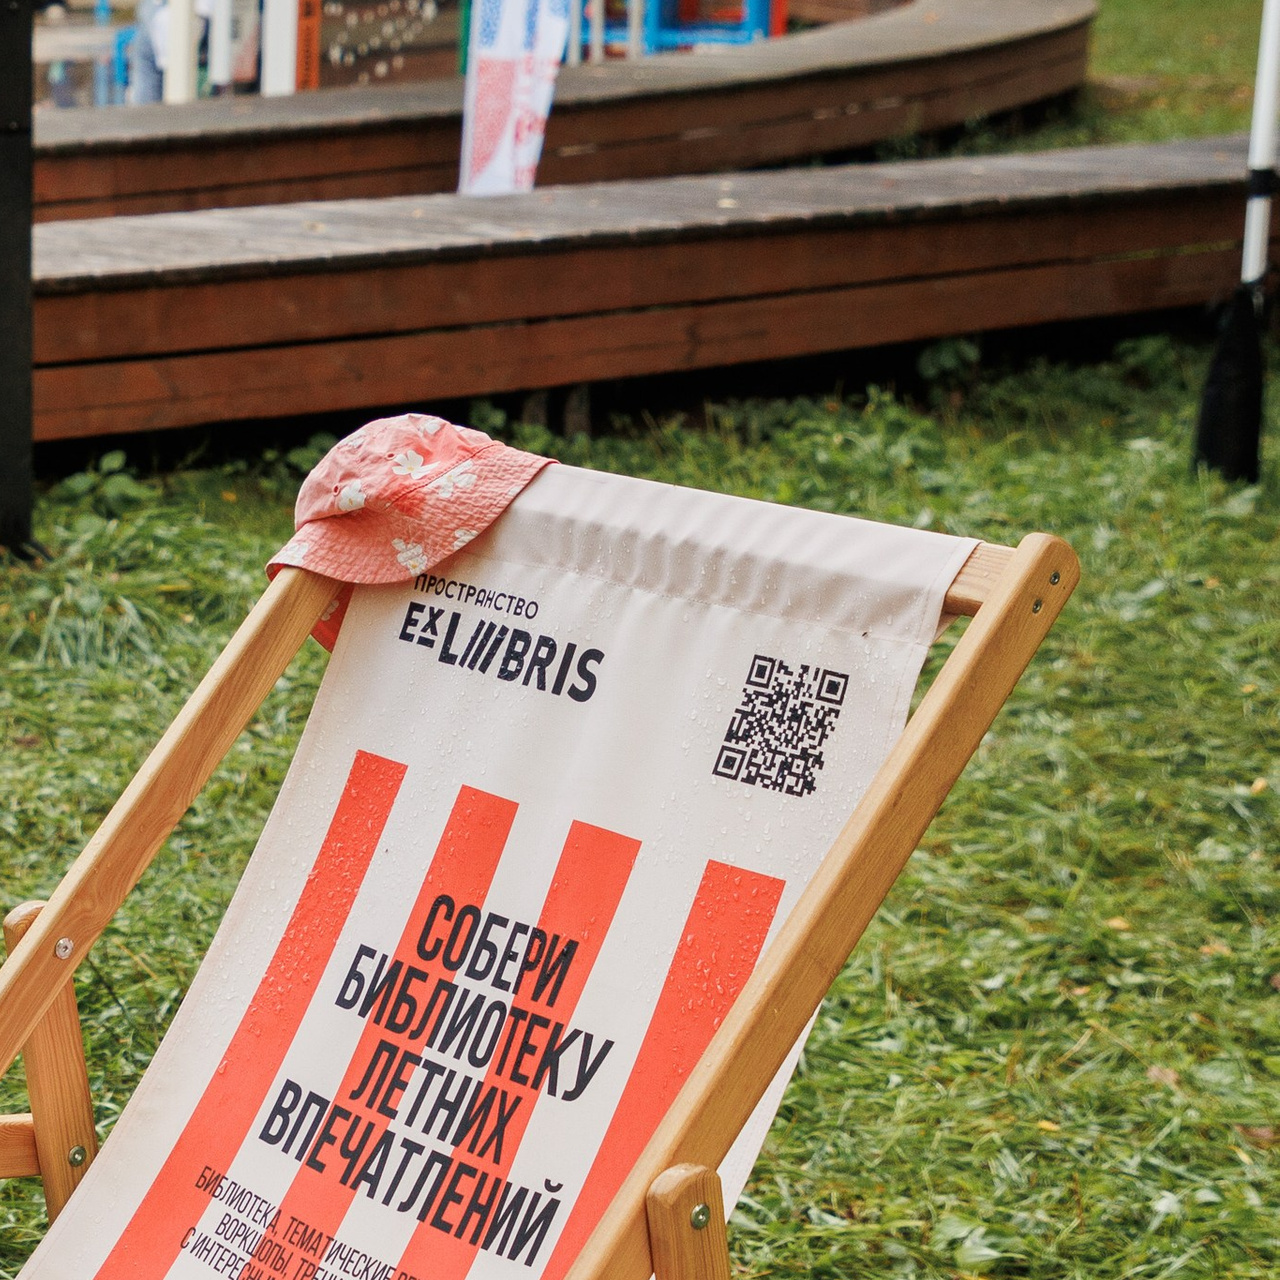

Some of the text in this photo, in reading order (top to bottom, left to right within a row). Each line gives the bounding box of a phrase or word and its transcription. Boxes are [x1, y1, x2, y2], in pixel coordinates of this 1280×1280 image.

[414, 573, 540, 620] ПРОСТРАНСТВО
[416, 894, 580, 1008] СОБЕРИ
[334, 945, 615, 1102] БИБЛИОТЕКУ
[349, 1039, 523, 1164] ЛЕТНИХ
[195, 1165, 283, 1236] БИБЛИОТЕКА,
[259, 1080, 565, 1267] ВПЕЧАТЛЕНИЙ
[180, 1226, 197, 1249] С
[214, 1212, 294, 1279] ВОРКШОПЫ,
